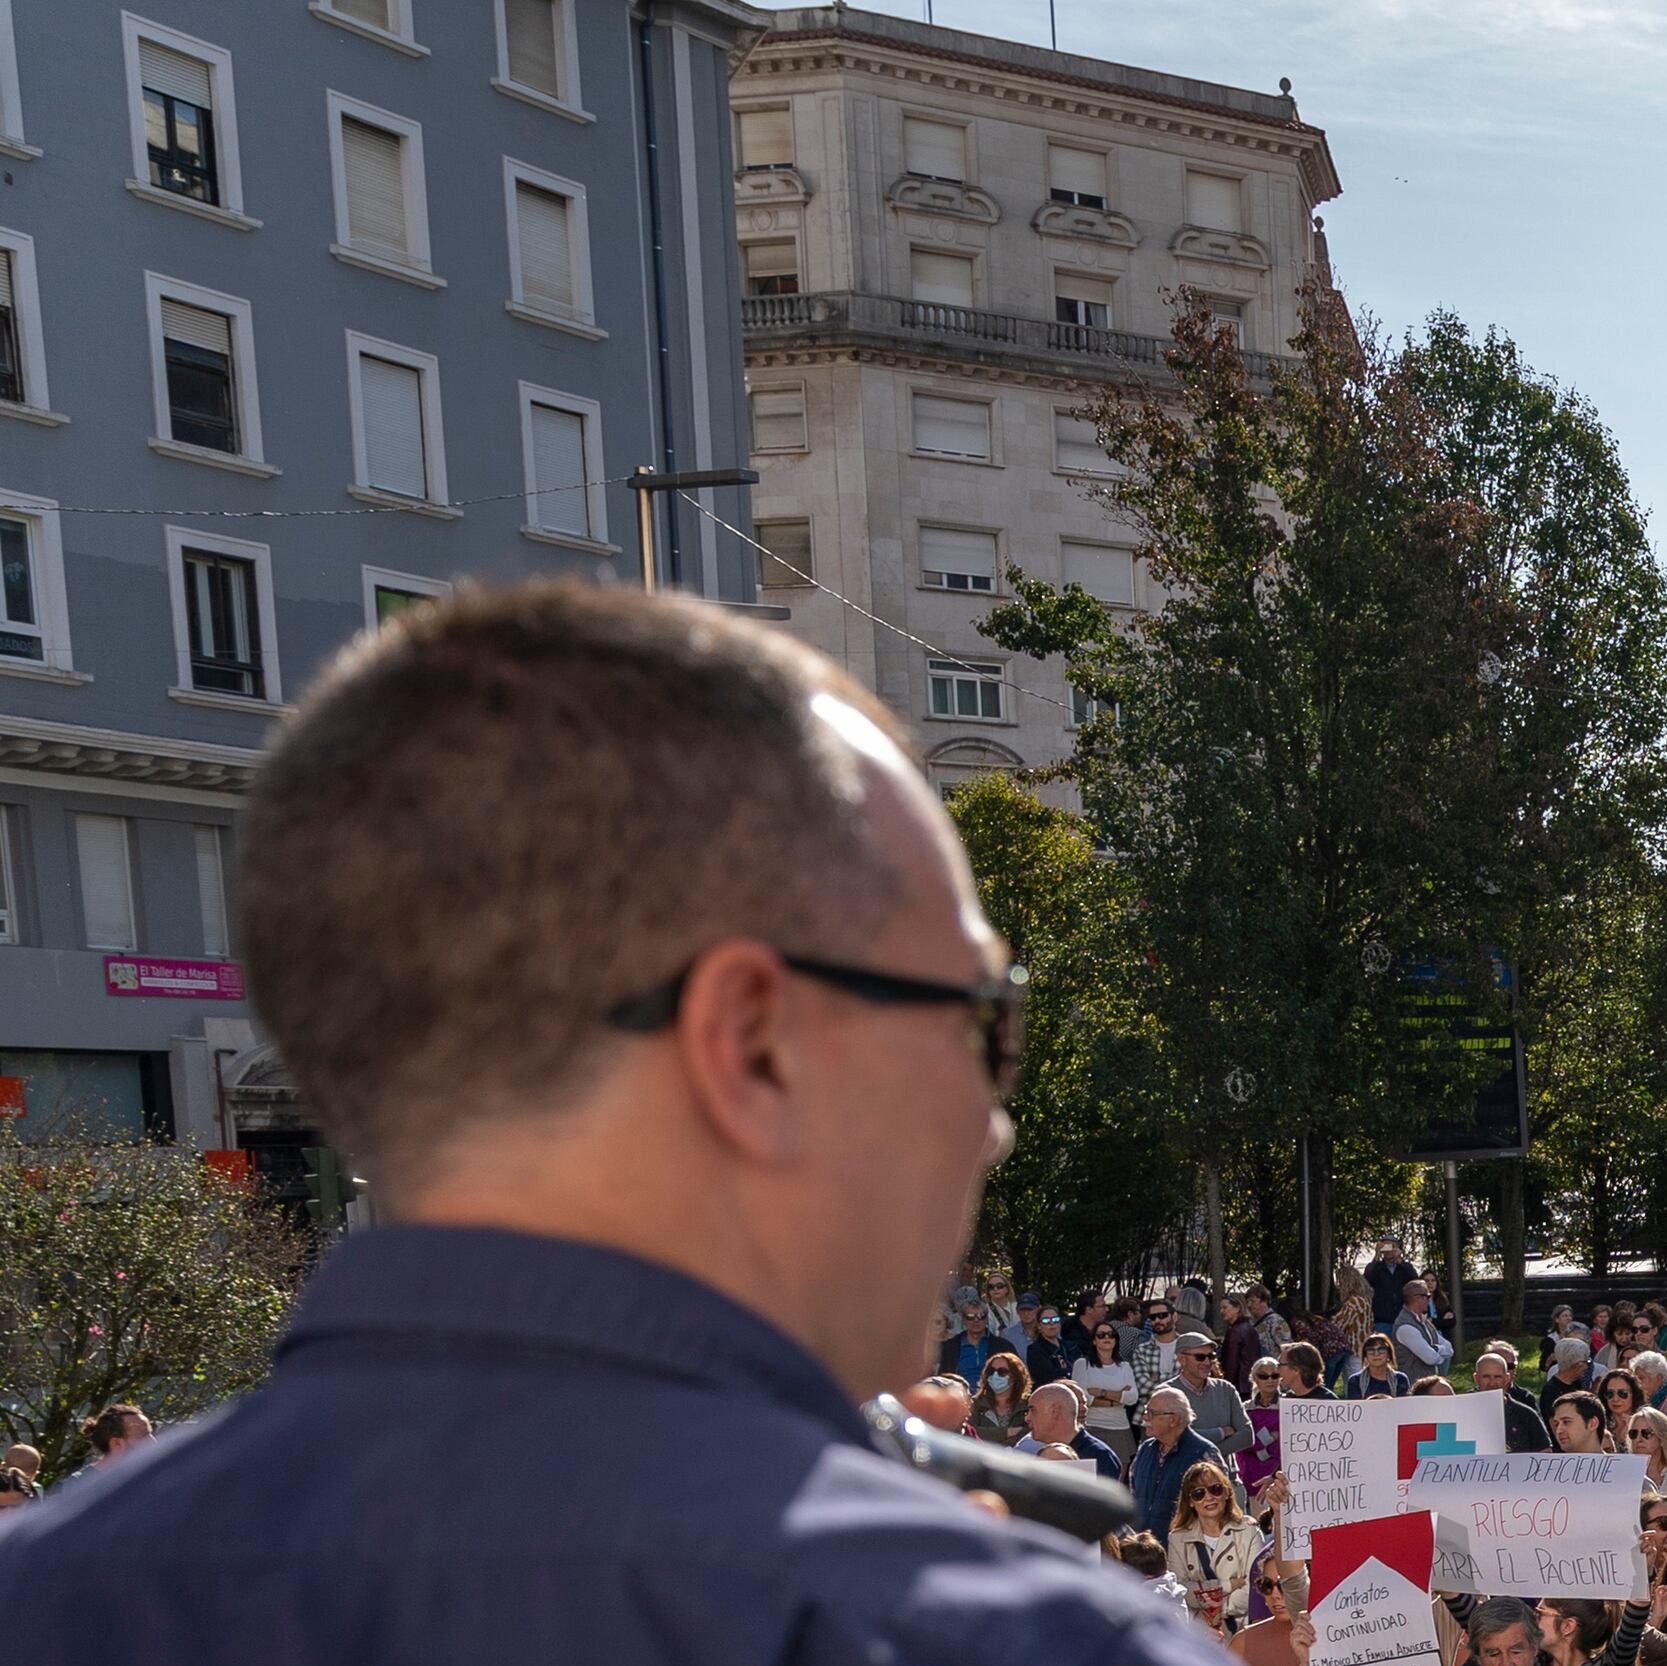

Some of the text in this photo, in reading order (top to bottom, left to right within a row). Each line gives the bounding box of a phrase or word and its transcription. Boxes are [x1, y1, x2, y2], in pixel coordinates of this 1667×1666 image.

[175, 967, 188, 978] de
[1420, 1457, 1623, 1484] PLANTILLA DEFICIENTE
[1471, 1496, 1570, 1540] RIESGO
[1432, 1547, 1484, 1581] PARA
[1499, 1548, 1530, 1584] EL
[1334, 1582, 1390, 1611] Contratos
[1350, 1606, 1366, 1620] de
[1326, 1613, 1407, 1643] CONTINUIDAD
